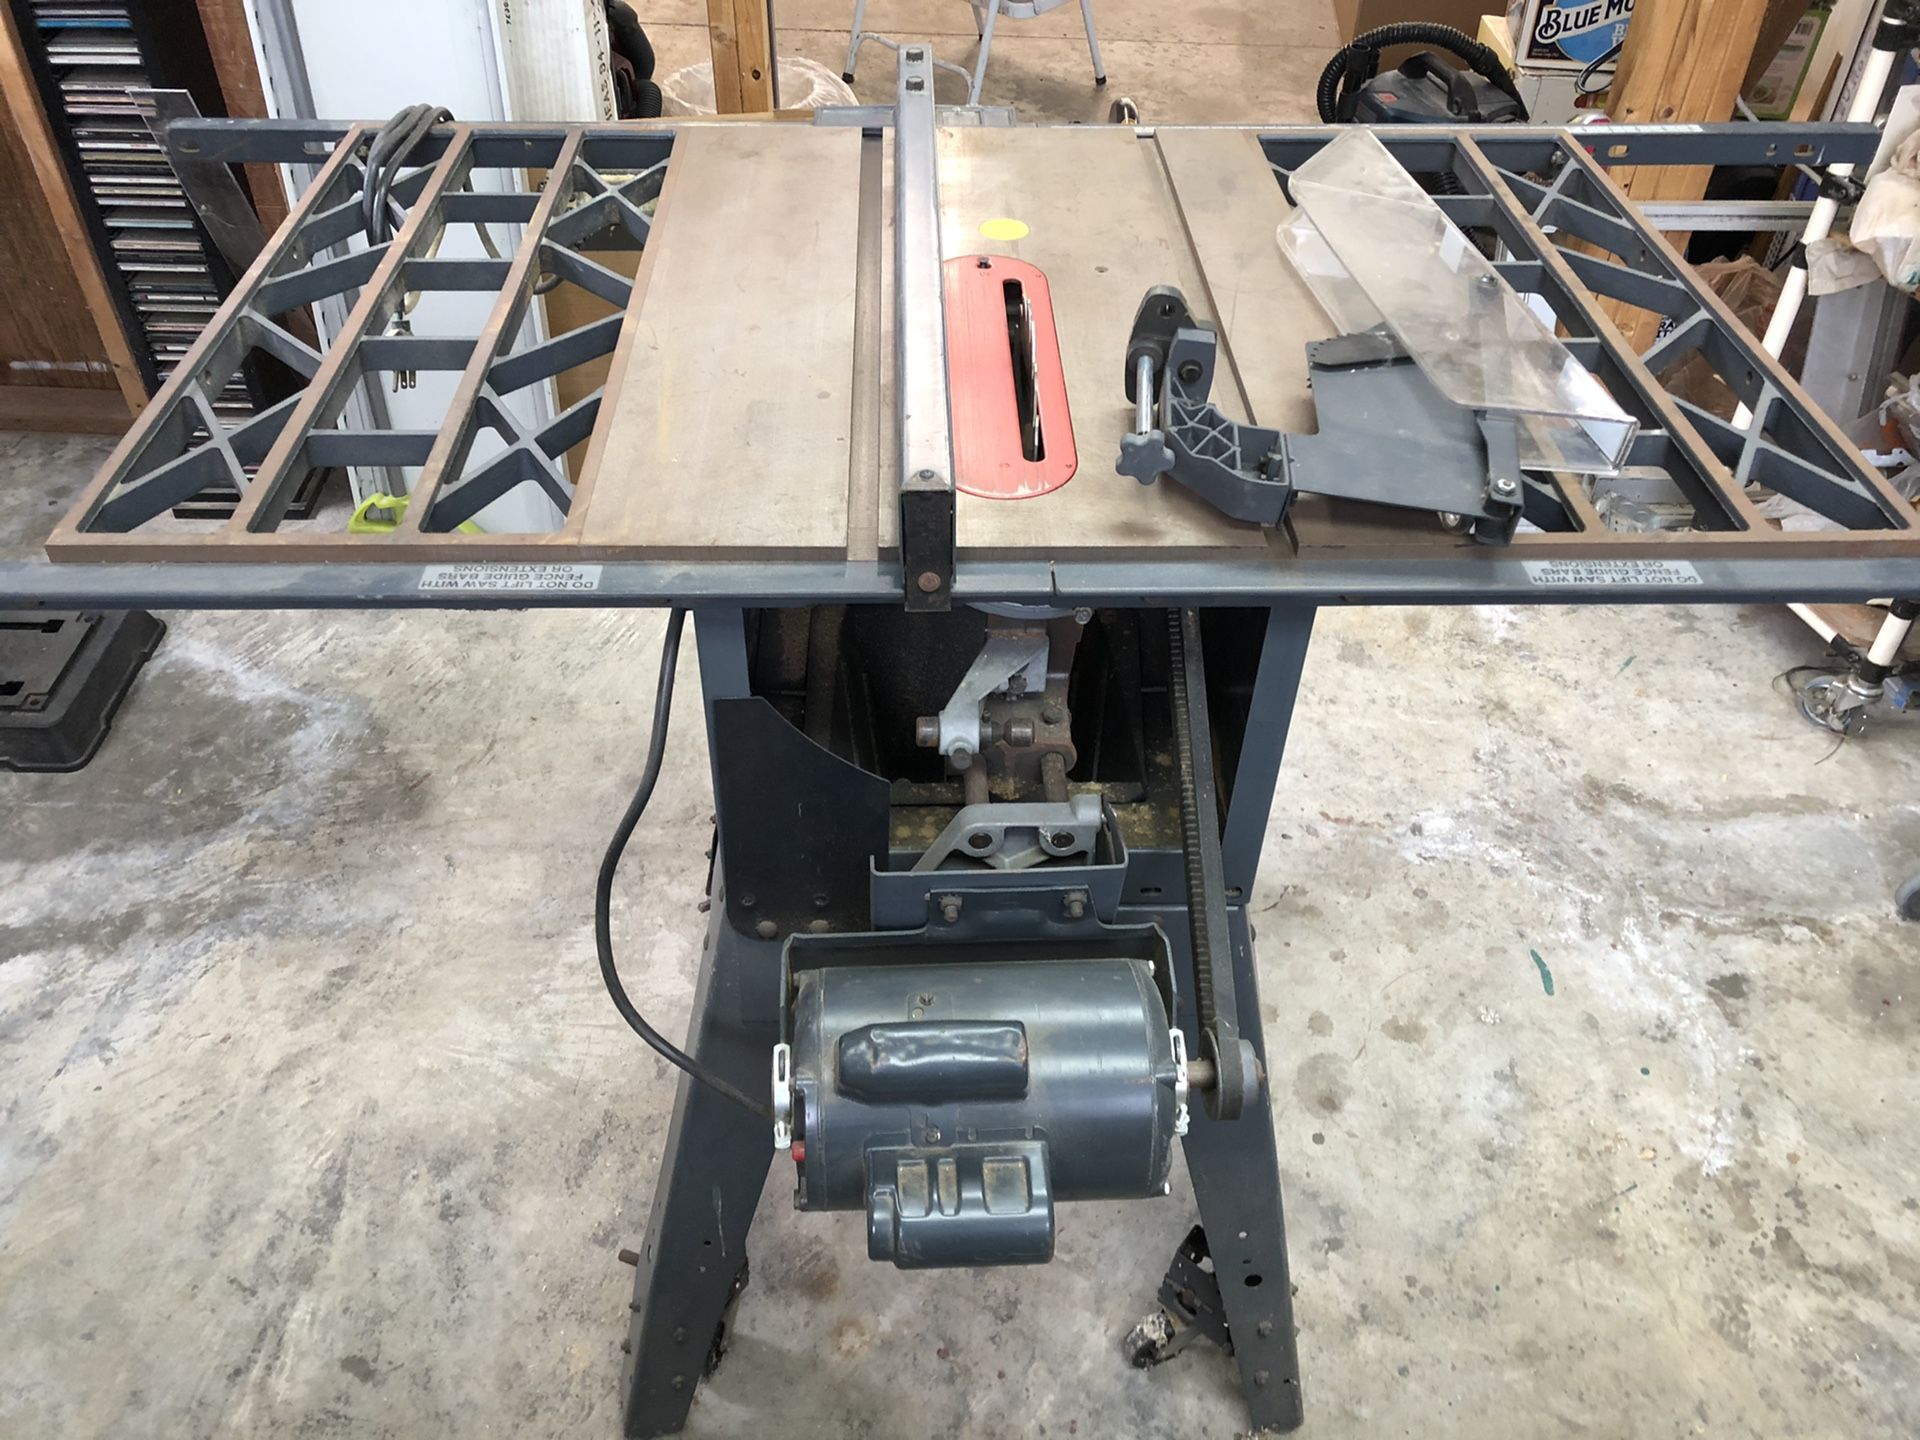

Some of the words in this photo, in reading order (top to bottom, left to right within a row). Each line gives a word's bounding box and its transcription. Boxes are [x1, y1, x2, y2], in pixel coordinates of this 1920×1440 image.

[1538, 5, 1602, 40] BLUE
[1604, 0, 1635, 20] MO
[1551, 560, 1639, 568] EXTENSIONS
[1641, 560, 1664, 569] OR
[453, 565, 548, 573] EXTENSIONS
[551, 565, 573, 573] OR
[1582, 568, 1629, 576] GUIDE
[1633, 568, 1680, 576] FENCE
[438, 572, 479, 580] BARS
[483, 572, 530, 581] GUIDE
[534, 573, 584, 581] FENCE
[1532, 575, 1570, 583] WITH
[1573, 575, 1606, 583] SAW
[1610, 575, 1640, 583] LIFT
[1644, 575, 1673, 583] NOT
[1676, 575, 1698, 583] DO
[421, 580, 459, 588] WITH
[463, 580, 498, 588] SAW
[502, 580, 533, 588] LIFT
[538, 580, 568, 589] NOT
[572, 581, 594, 589] DO
